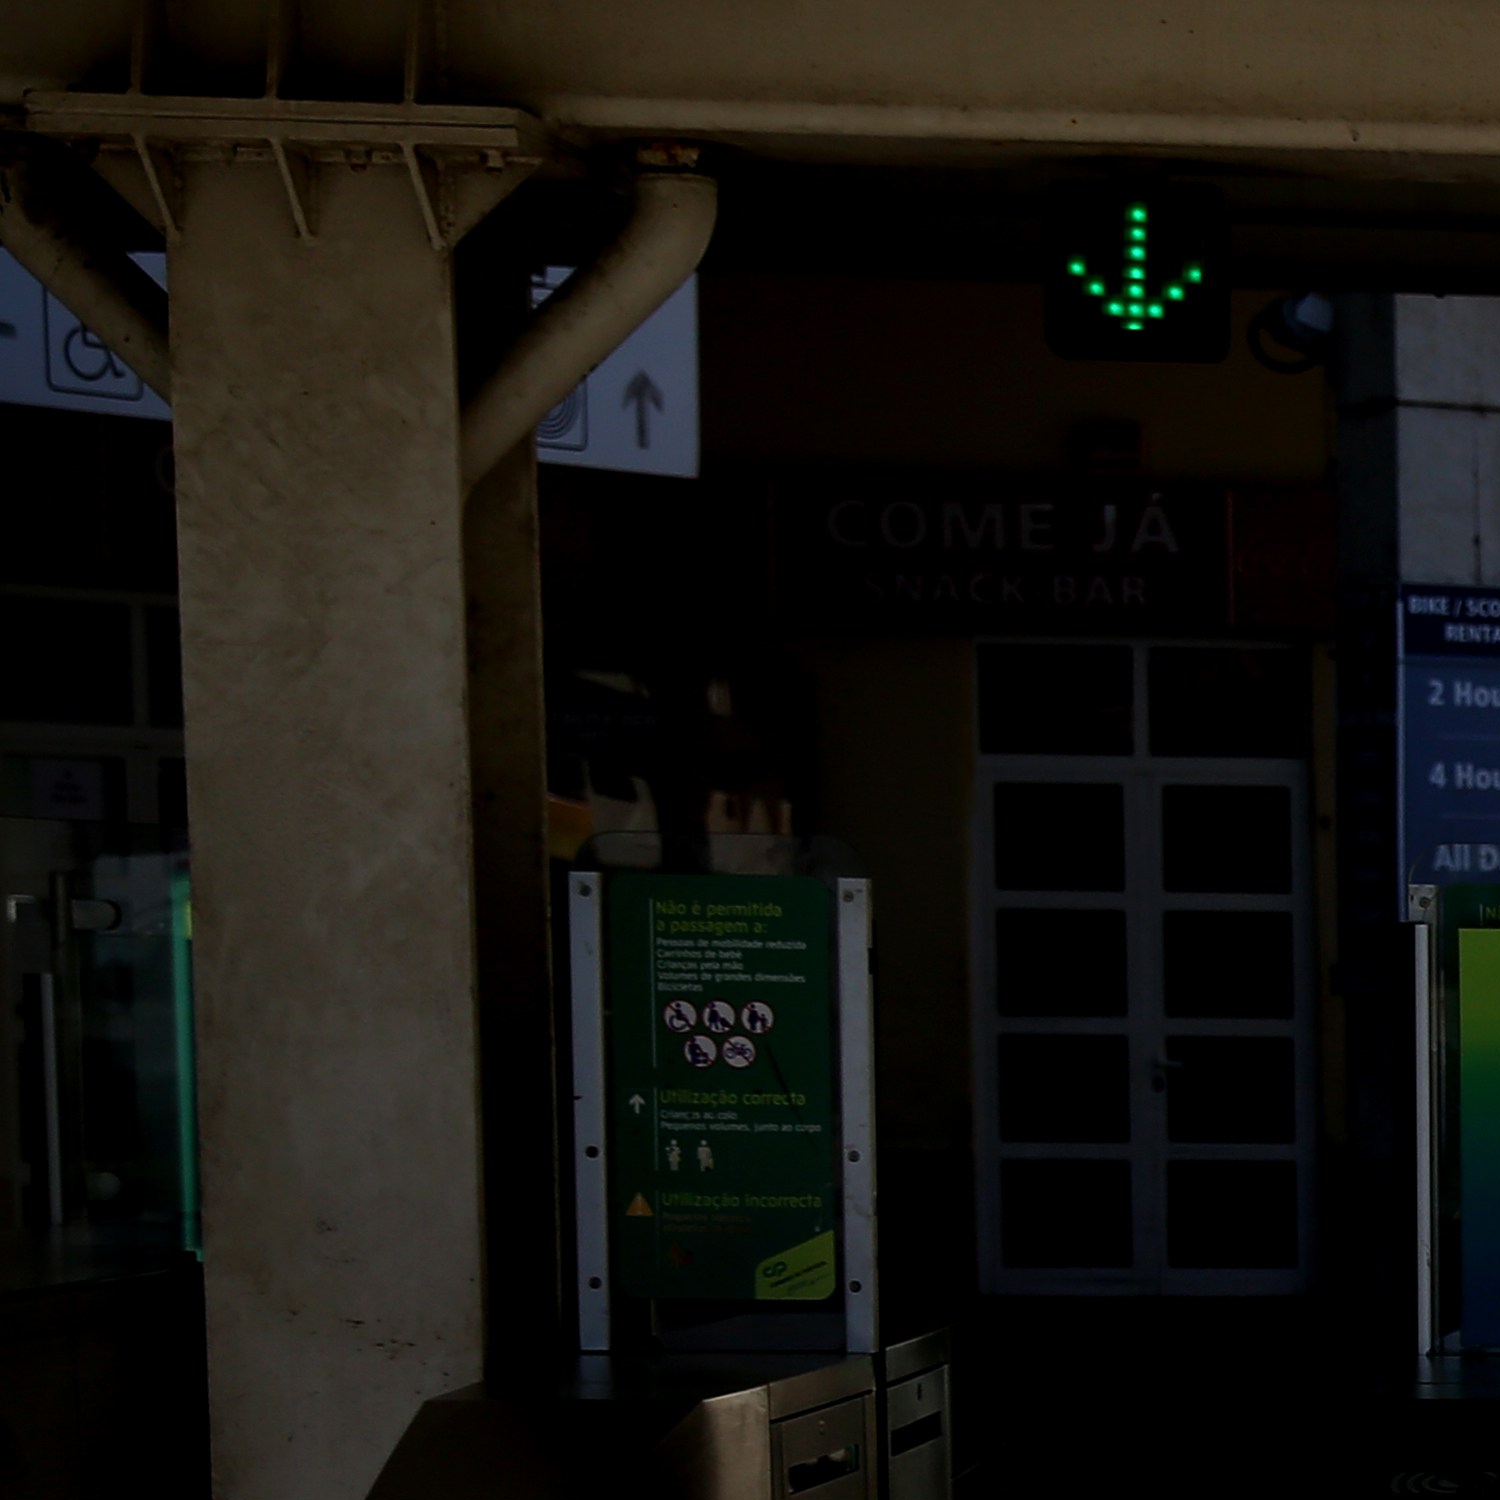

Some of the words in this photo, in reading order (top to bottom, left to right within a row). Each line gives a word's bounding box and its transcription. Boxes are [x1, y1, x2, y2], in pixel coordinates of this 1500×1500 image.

[826, 499, 1056, 553] COME
[1091, 486, 1181, 556] JÁ
[1407, 594, 1450, 617] BIKE
[1427, 679, 1445, 707] 2
[1428, 762, 1447, 789] 4
[1433, 843, 1471, 872] All
[655, 900, 687, 915] Não
[691, 900, 702, 915] é
[705, 901, 784, 919] permitida
[670, 920, 750, 936] passagem
[660, 1089, 738, 1108] Utilização
[741, 1092, 807, 1106] correcta
[661, 1192, 740, 1209] Utilização
[744, 1193, 823, 1208] incorrecta
